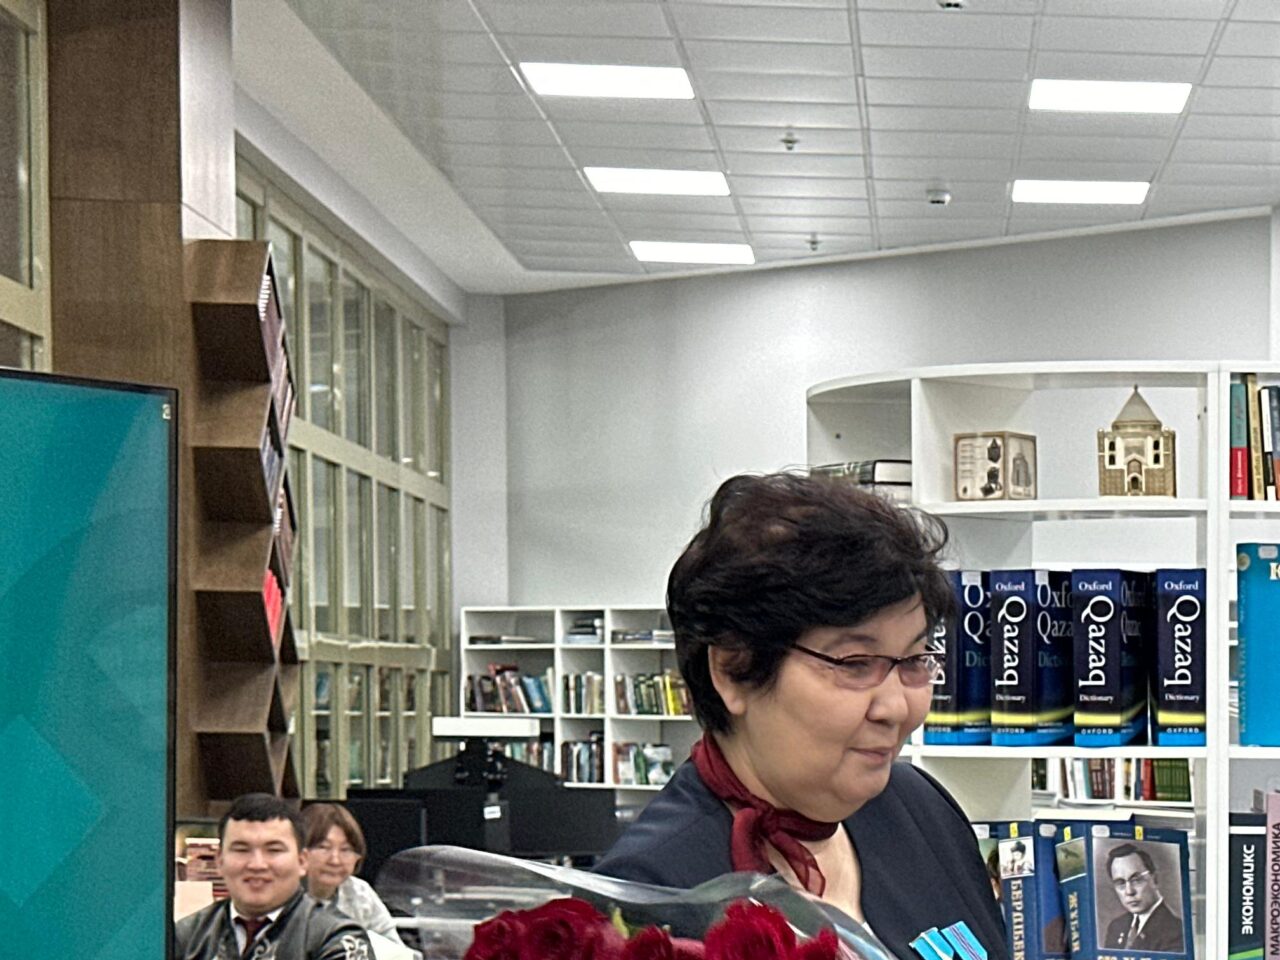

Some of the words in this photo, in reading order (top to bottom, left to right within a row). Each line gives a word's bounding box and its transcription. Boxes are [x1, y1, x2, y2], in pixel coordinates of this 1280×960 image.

[995, 582, 1025, 592] Oxford
[1079, 581, 1112, 592] Oxford
[1164, 580, 1199, 592] Oxford
[995, 596, 1027, 687] Qazaq
[1078, 595, 1114, 688] Qazaq
[1163, 594, 1201, 688] Qazaq
[1241, 844, 1255, 935] ЭКОНОМИКС
